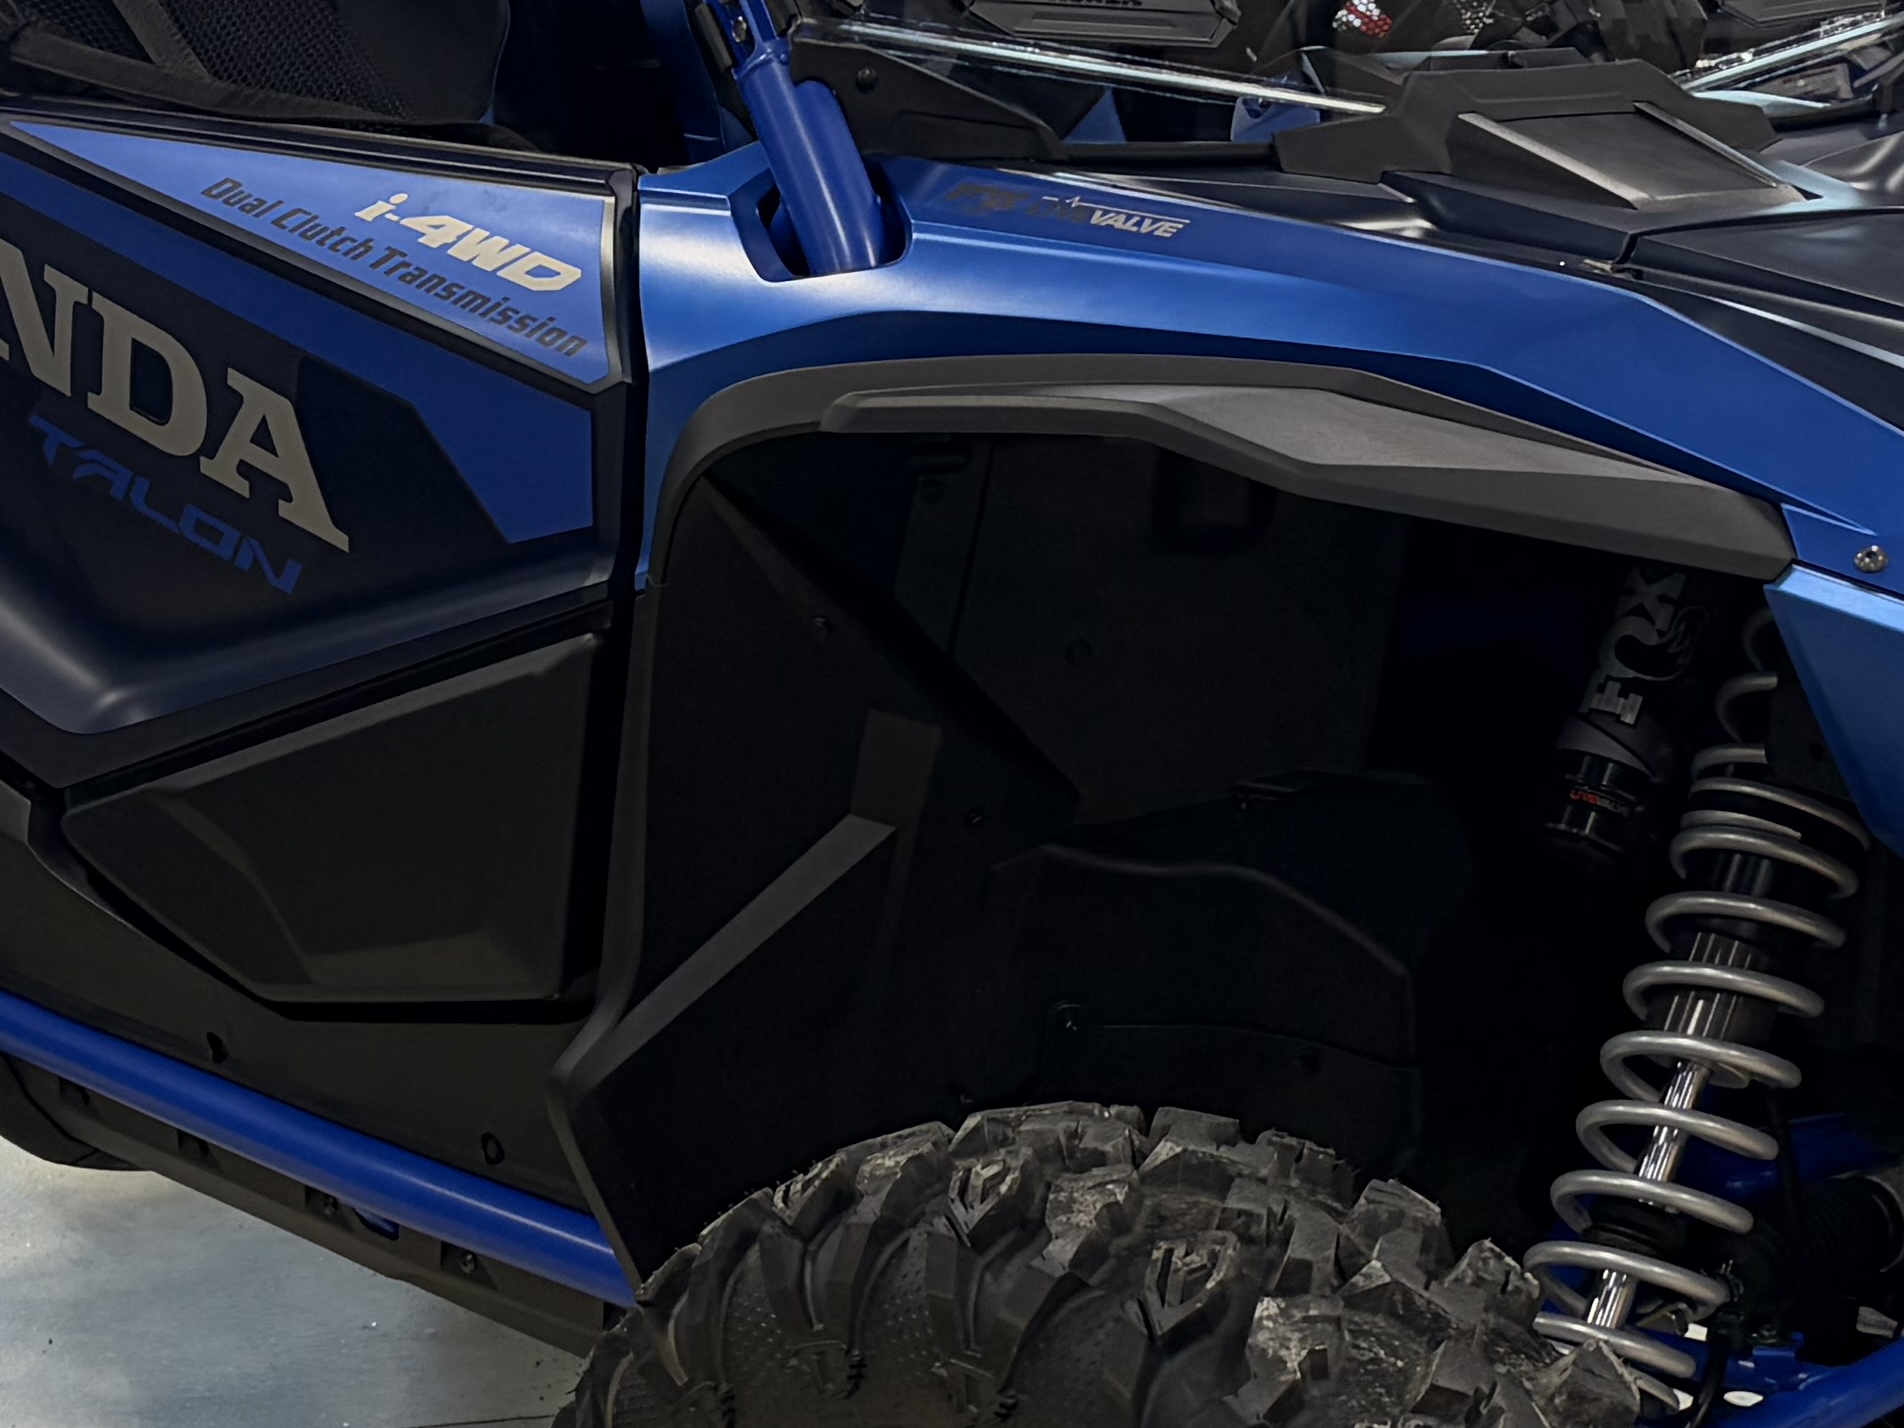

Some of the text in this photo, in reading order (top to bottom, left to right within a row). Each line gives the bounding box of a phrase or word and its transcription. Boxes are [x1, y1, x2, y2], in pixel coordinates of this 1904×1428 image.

[201, 177, 589, 358] Dual Clutch Transmission
[354, 192, 582, 292] i-4WD
[27, 413, 303, 595] TALON
[1578, 566, 1702, 725] FOX
